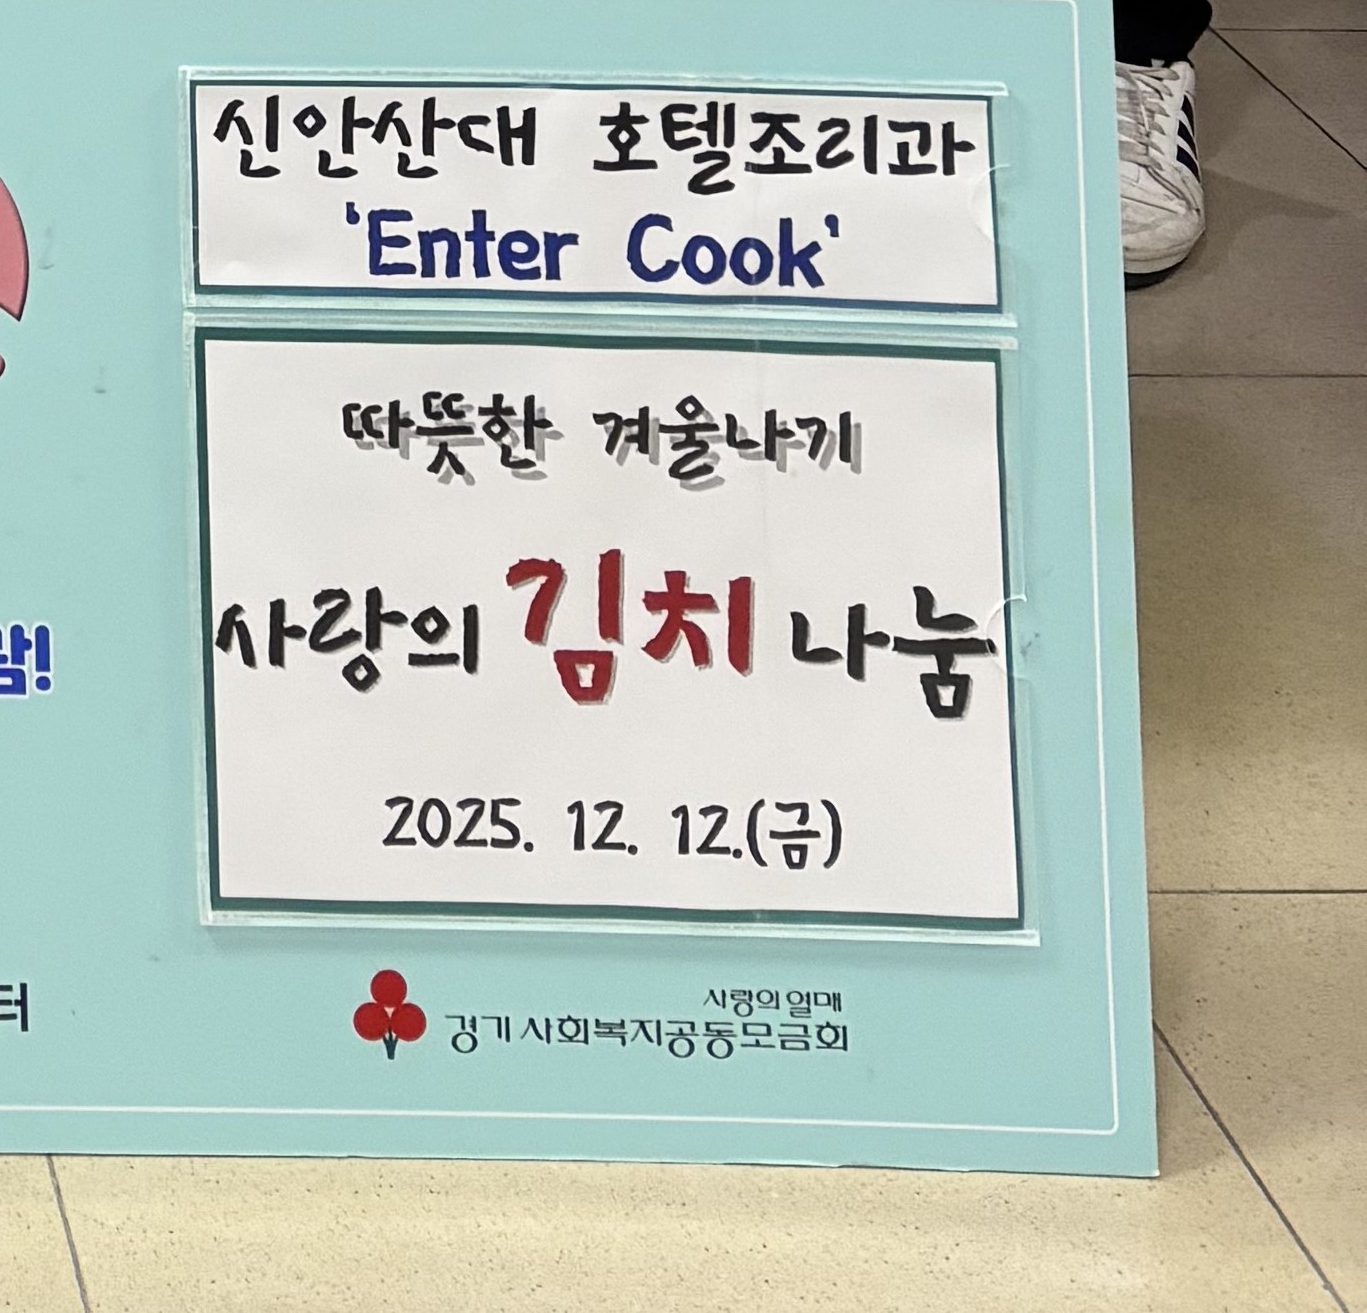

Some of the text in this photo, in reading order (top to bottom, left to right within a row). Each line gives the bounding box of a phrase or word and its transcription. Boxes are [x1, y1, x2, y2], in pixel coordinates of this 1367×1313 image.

[214, 94, 978, 196] 신안산대 호텔조리과
[342, 391, 862, 489] 따뜻한 겨울나기
[215, 548, 998, 721] 사랑의 김치 나눔
[382, 796, 844, 871] 2025. 12. 12.(금)
[444, 1014, 850, 1060] 경기 사회복지공동모금회
